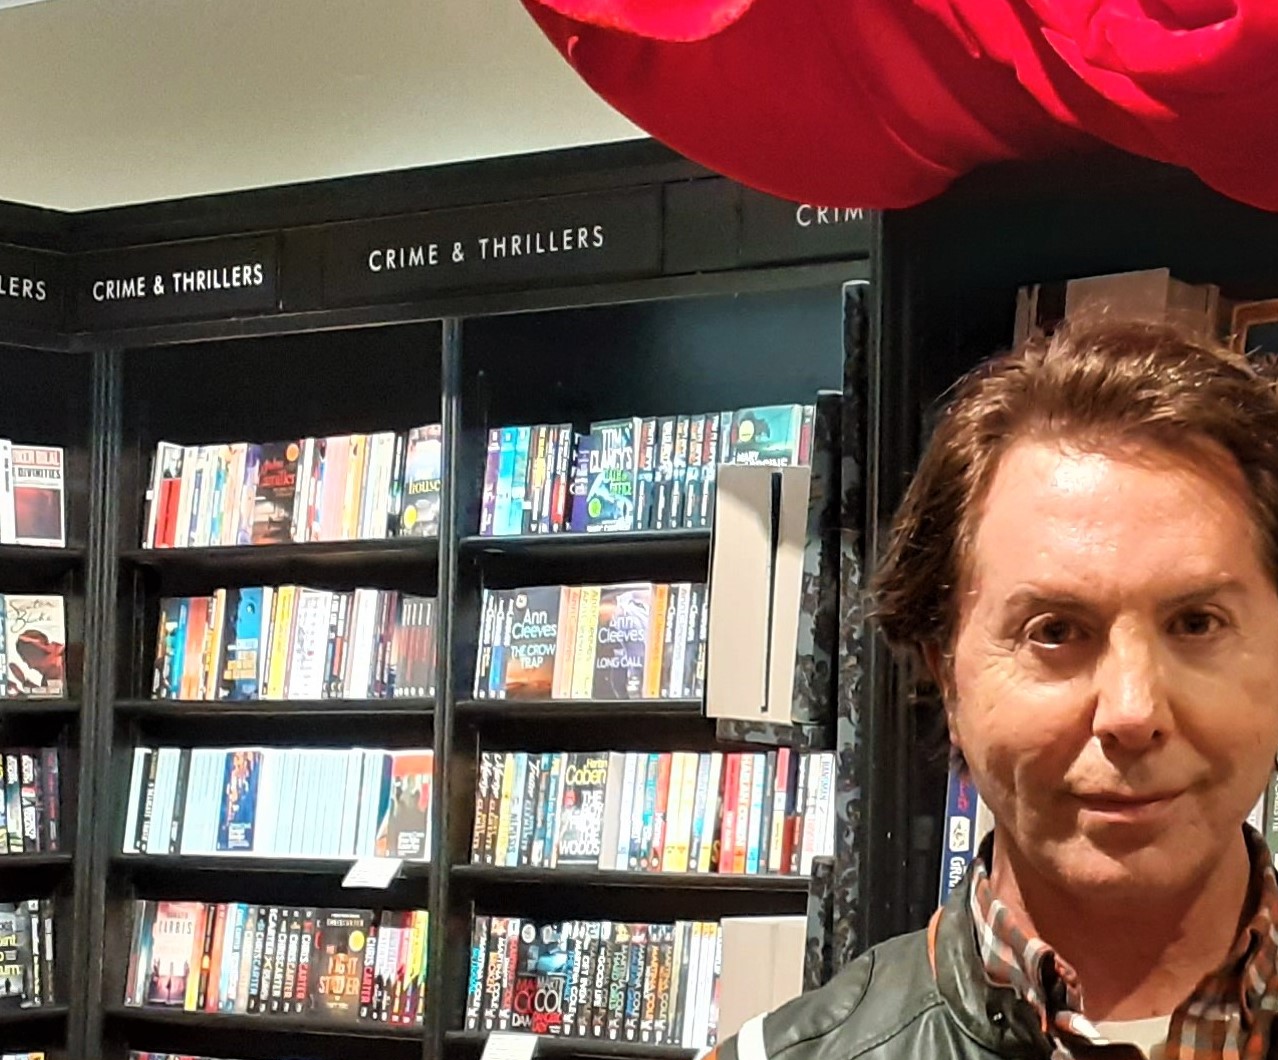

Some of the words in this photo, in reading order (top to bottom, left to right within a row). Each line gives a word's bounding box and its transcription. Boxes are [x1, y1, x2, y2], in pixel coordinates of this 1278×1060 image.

[367, 243, 438, 272] CRIME
[451, 241, 465, 262] &
[478, 225, 604, 259] THRILLERS
[92, 279, 146, 302] CRIME
[153, 274, 165, 295] &
[172, 263, 264, 293] THRILLERS
[522, 609, 548, 625] Ann
[511, 622, 557, 639] Cleeves
[597, 627, 645, 643] Cleeves
[520, 657, 544, 669] TRAP
[596, 657, 619, 669] LONG
[620, 655, 643, 669] CALL
[565, 764, 607, 786] Coben
[559, 841, 600, 856] WOODS
[295, 963, 309, 1000] CARTER
